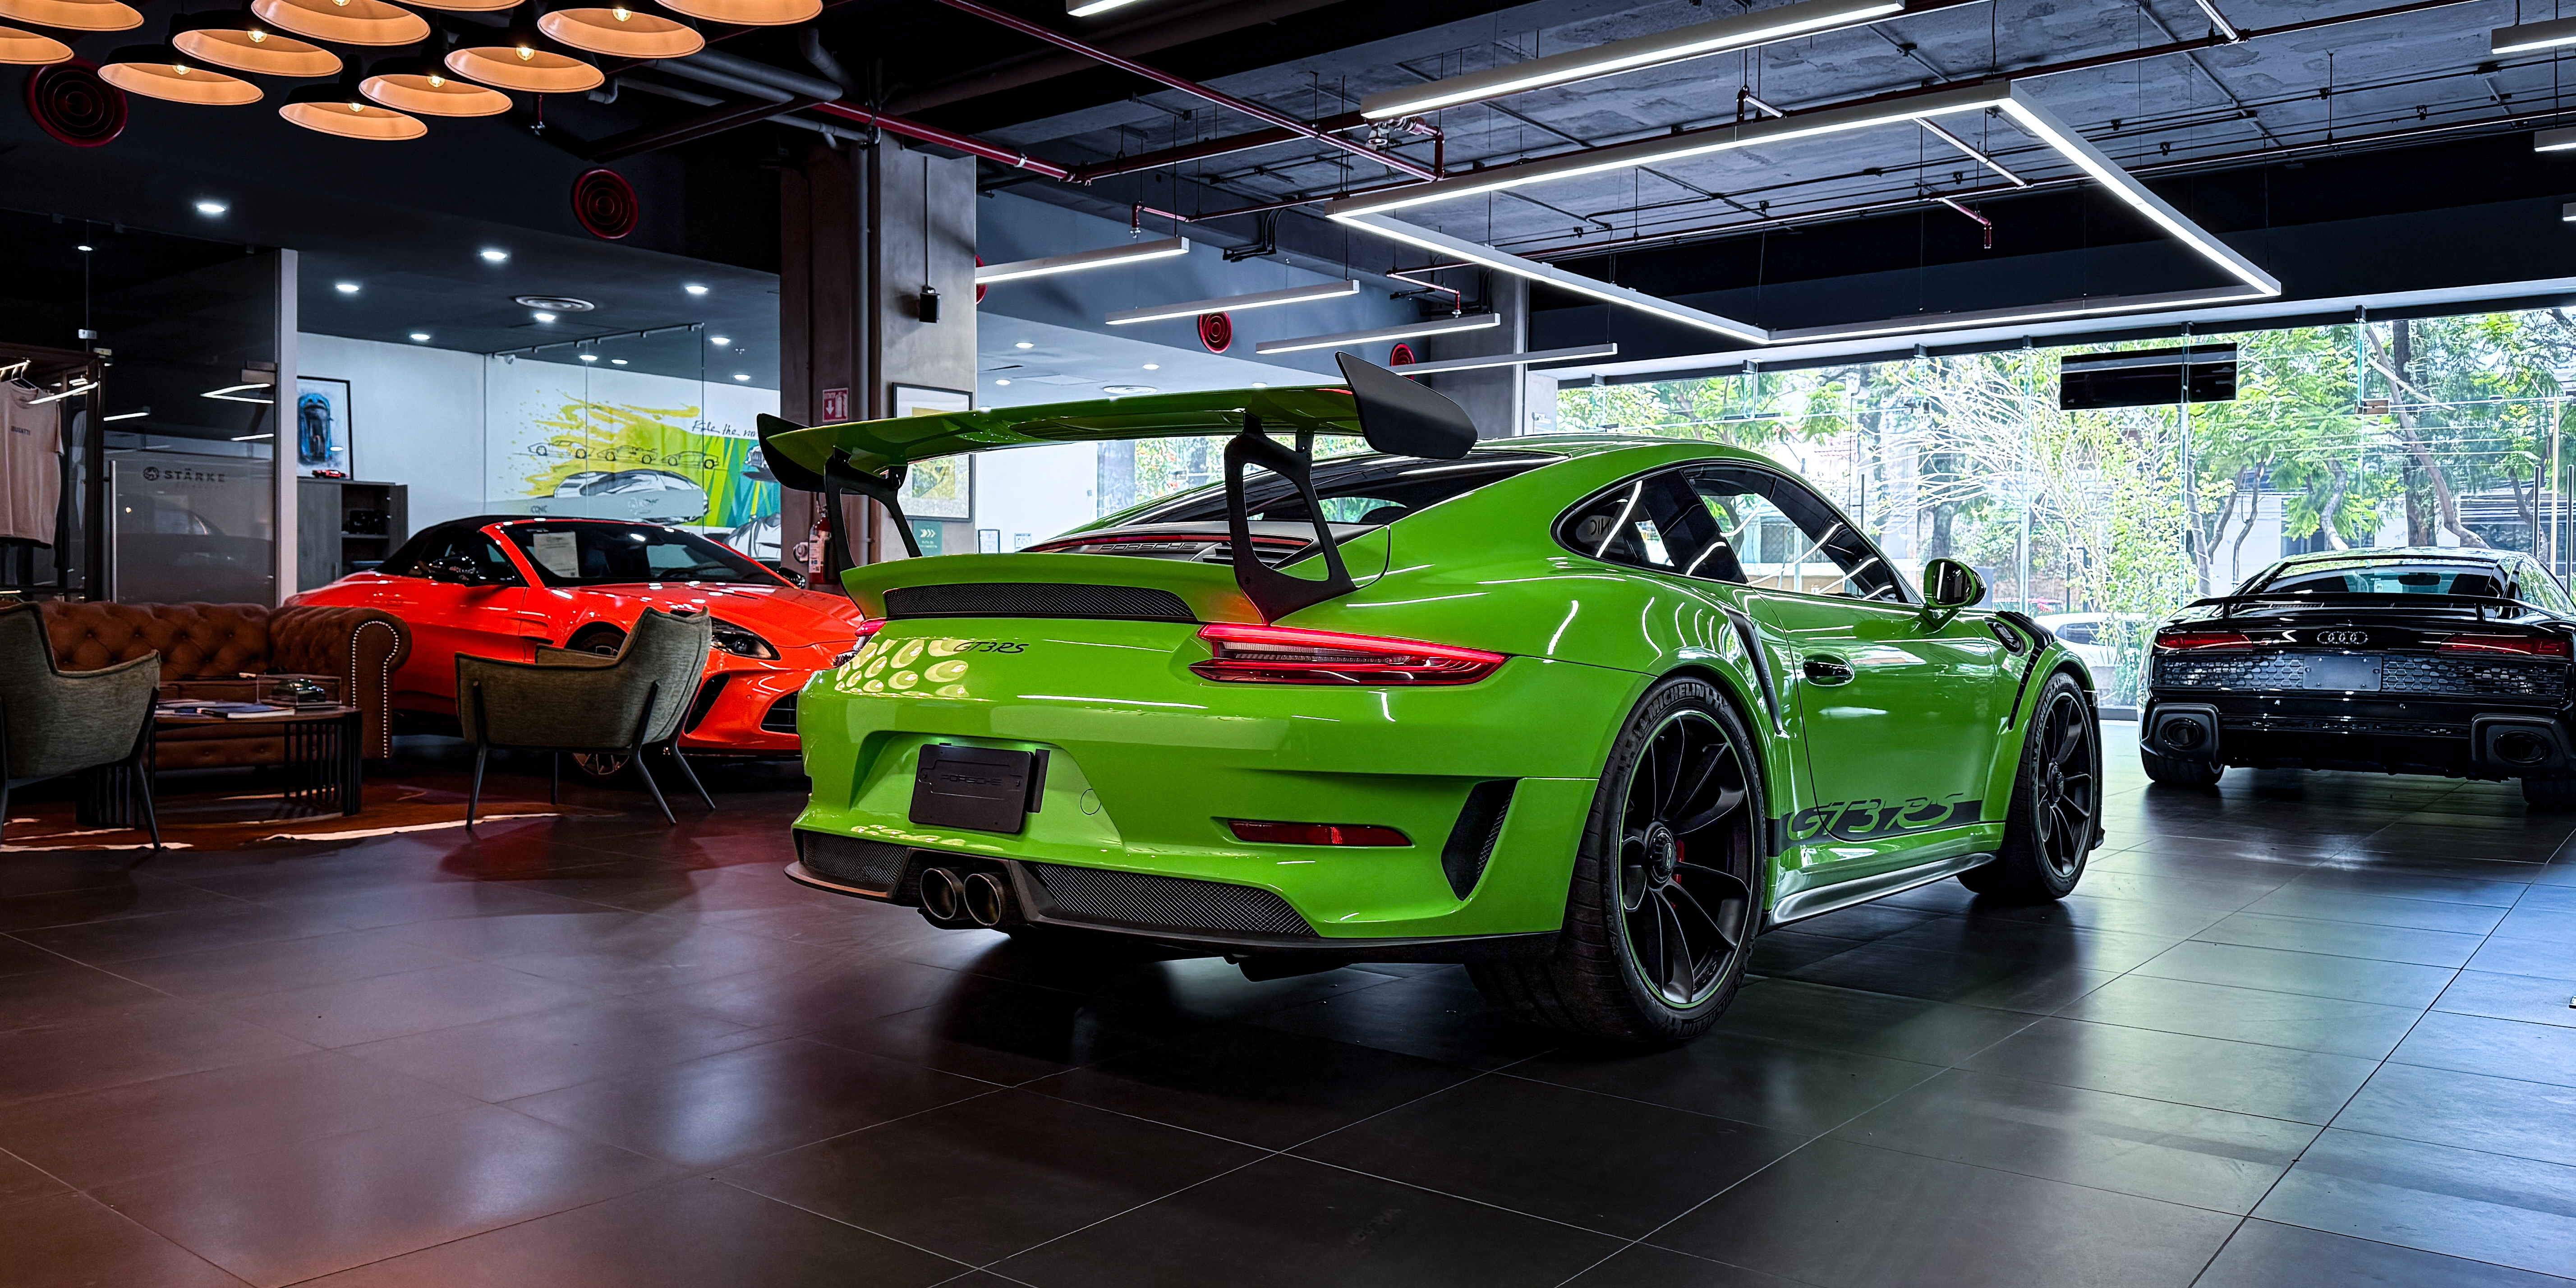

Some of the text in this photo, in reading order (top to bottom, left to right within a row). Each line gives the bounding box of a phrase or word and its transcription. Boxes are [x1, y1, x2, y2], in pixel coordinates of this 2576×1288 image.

[164, 468, 225, 482] STÄRKE
[1098, 543, 1198, 552] PORSCHE
[1648, 683, 1705, 720] MICHELIN
[2035, 690, 2053, 745] MICHELIN
[941, 774, 1002, 786] PORSCHE
